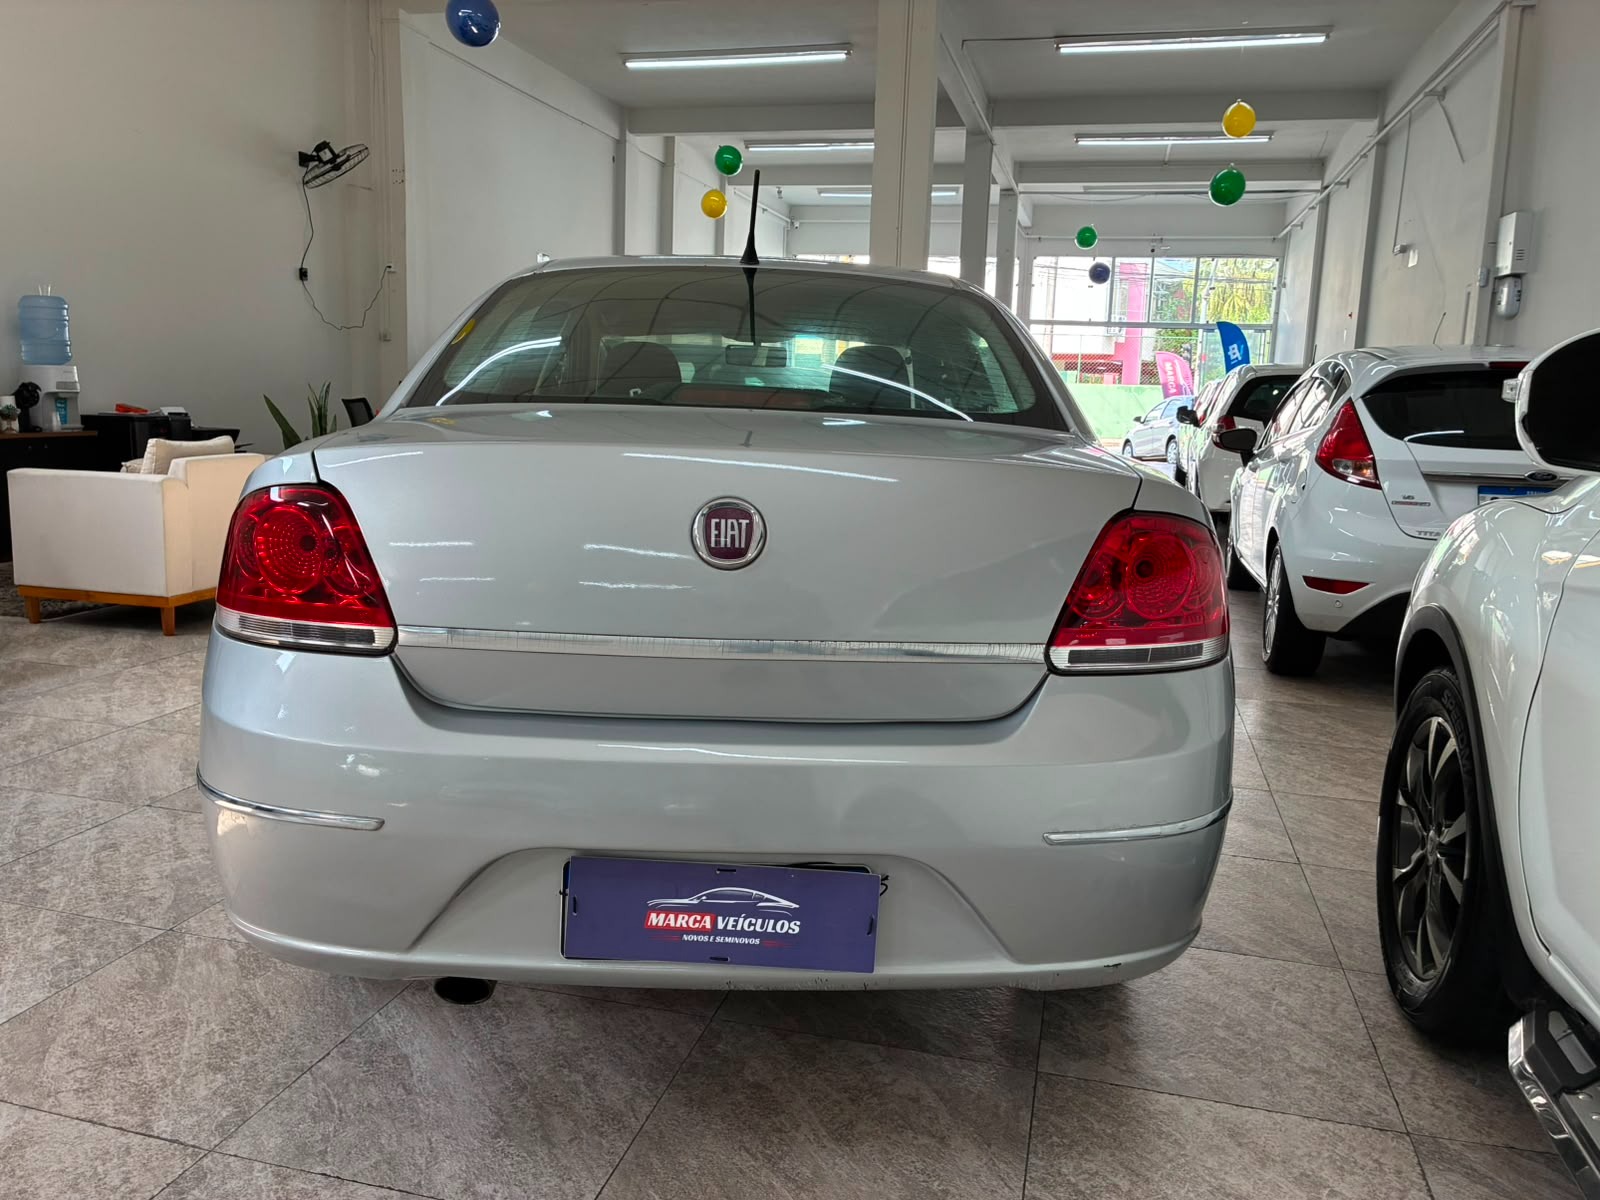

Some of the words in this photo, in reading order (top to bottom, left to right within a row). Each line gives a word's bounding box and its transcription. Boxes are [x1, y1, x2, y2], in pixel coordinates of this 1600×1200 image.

[1164, 361, 1177, 393] MARCA
[710, 518, 750, 548] FIAT
[647, 912, 711, 929] MARCA
[717, 914, 801, 934] VEÍCULOS
[682, 934, 709, 942] NOVOS
[715, 936, 760, 945] SEMINOVOS
